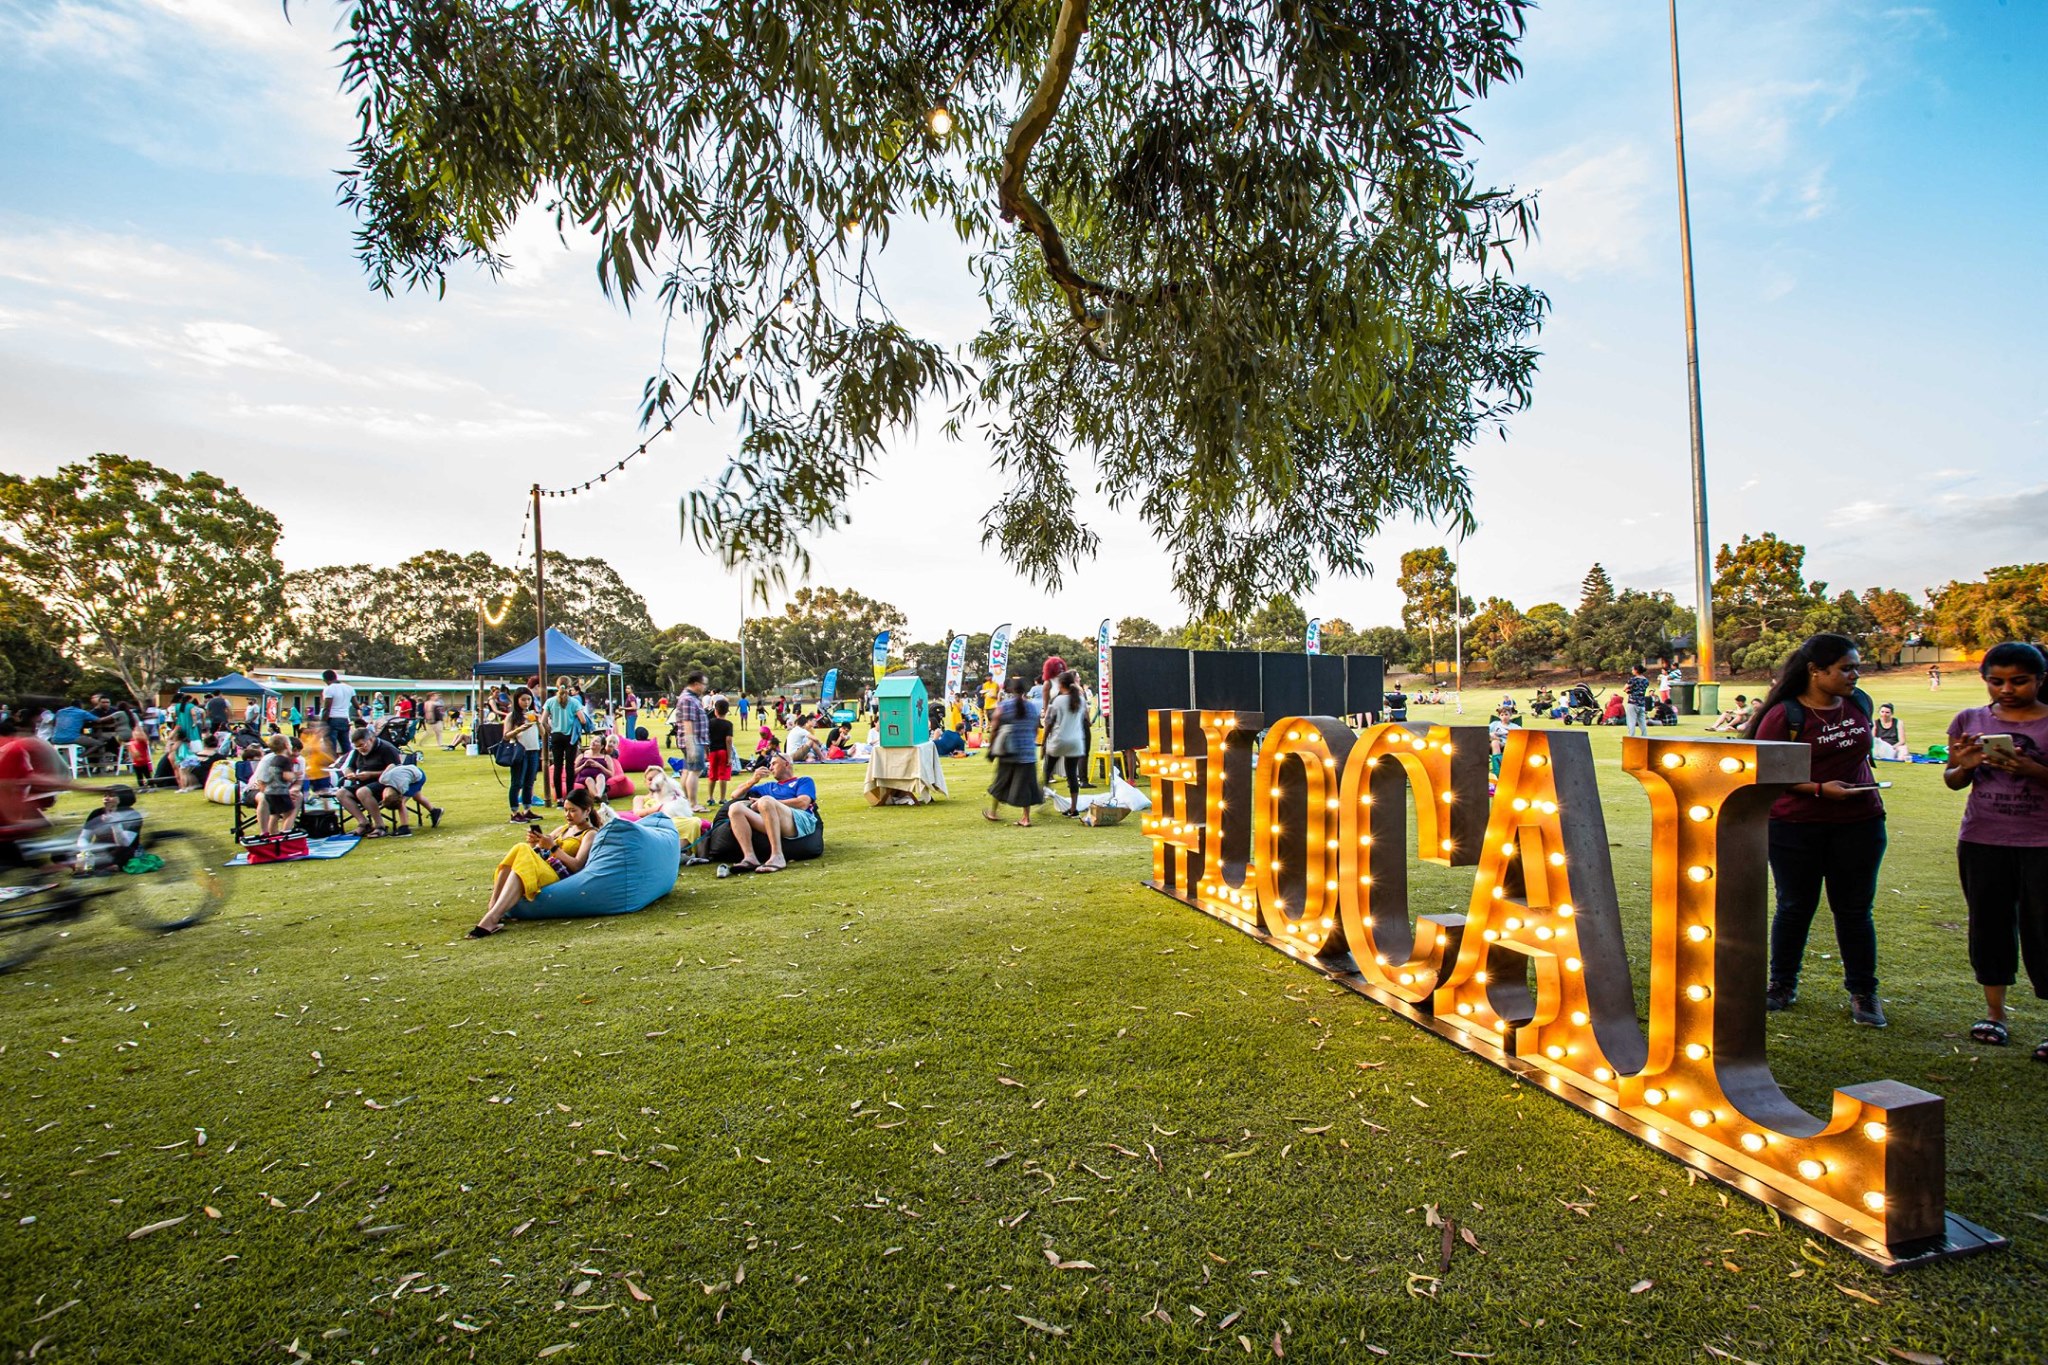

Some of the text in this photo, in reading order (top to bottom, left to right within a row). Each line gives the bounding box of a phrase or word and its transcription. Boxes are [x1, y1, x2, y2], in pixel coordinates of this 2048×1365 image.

[948, 637, 963, 676] circus
[989, 632, 1006, 676] circus
[1308, 623, 1317, 656] rcus
[1817, 727, 1866, 743] THERE FOR
[1140, 708, 1946, 1246] #LOCAL
